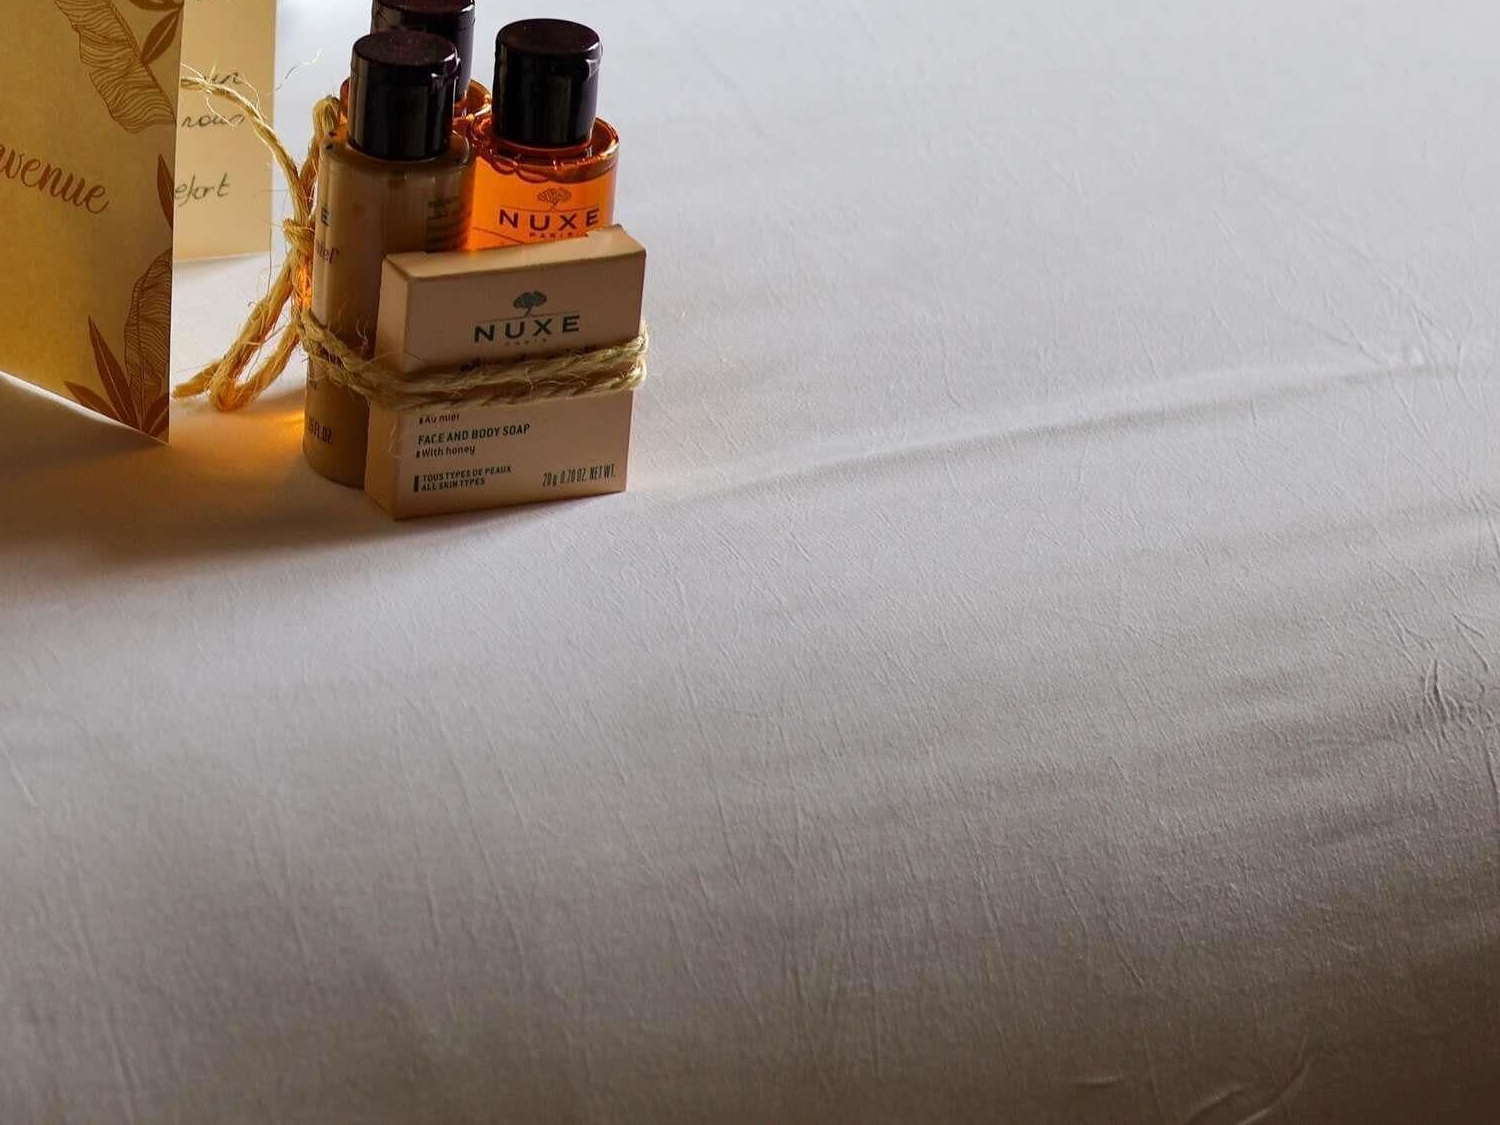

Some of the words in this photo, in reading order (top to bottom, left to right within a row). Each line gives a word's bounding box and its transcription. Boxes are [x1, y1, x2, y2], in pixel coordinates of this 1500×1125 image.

[174, 172, 230, 207] efort
[499, 208, 601, 232] NUXE
[474, 315, 580, 343] NUXE
[418, 433, 446, 445] FACE
[446, 430, 469, 442] AND
[471, 427, 501, 440] BODY
[502, 423, 531, 436] SOAP
[422, 446, 444, 458] With
[445, 444, 476, 457] honey
[421, 482, 437, 492] ALL
[459, 477, 485, 488] TYPES
[422, 472, 444, 482] TOUS
[446, 470, 473, 479] TYPES
[484, 465, 512, 476] PEAUX
